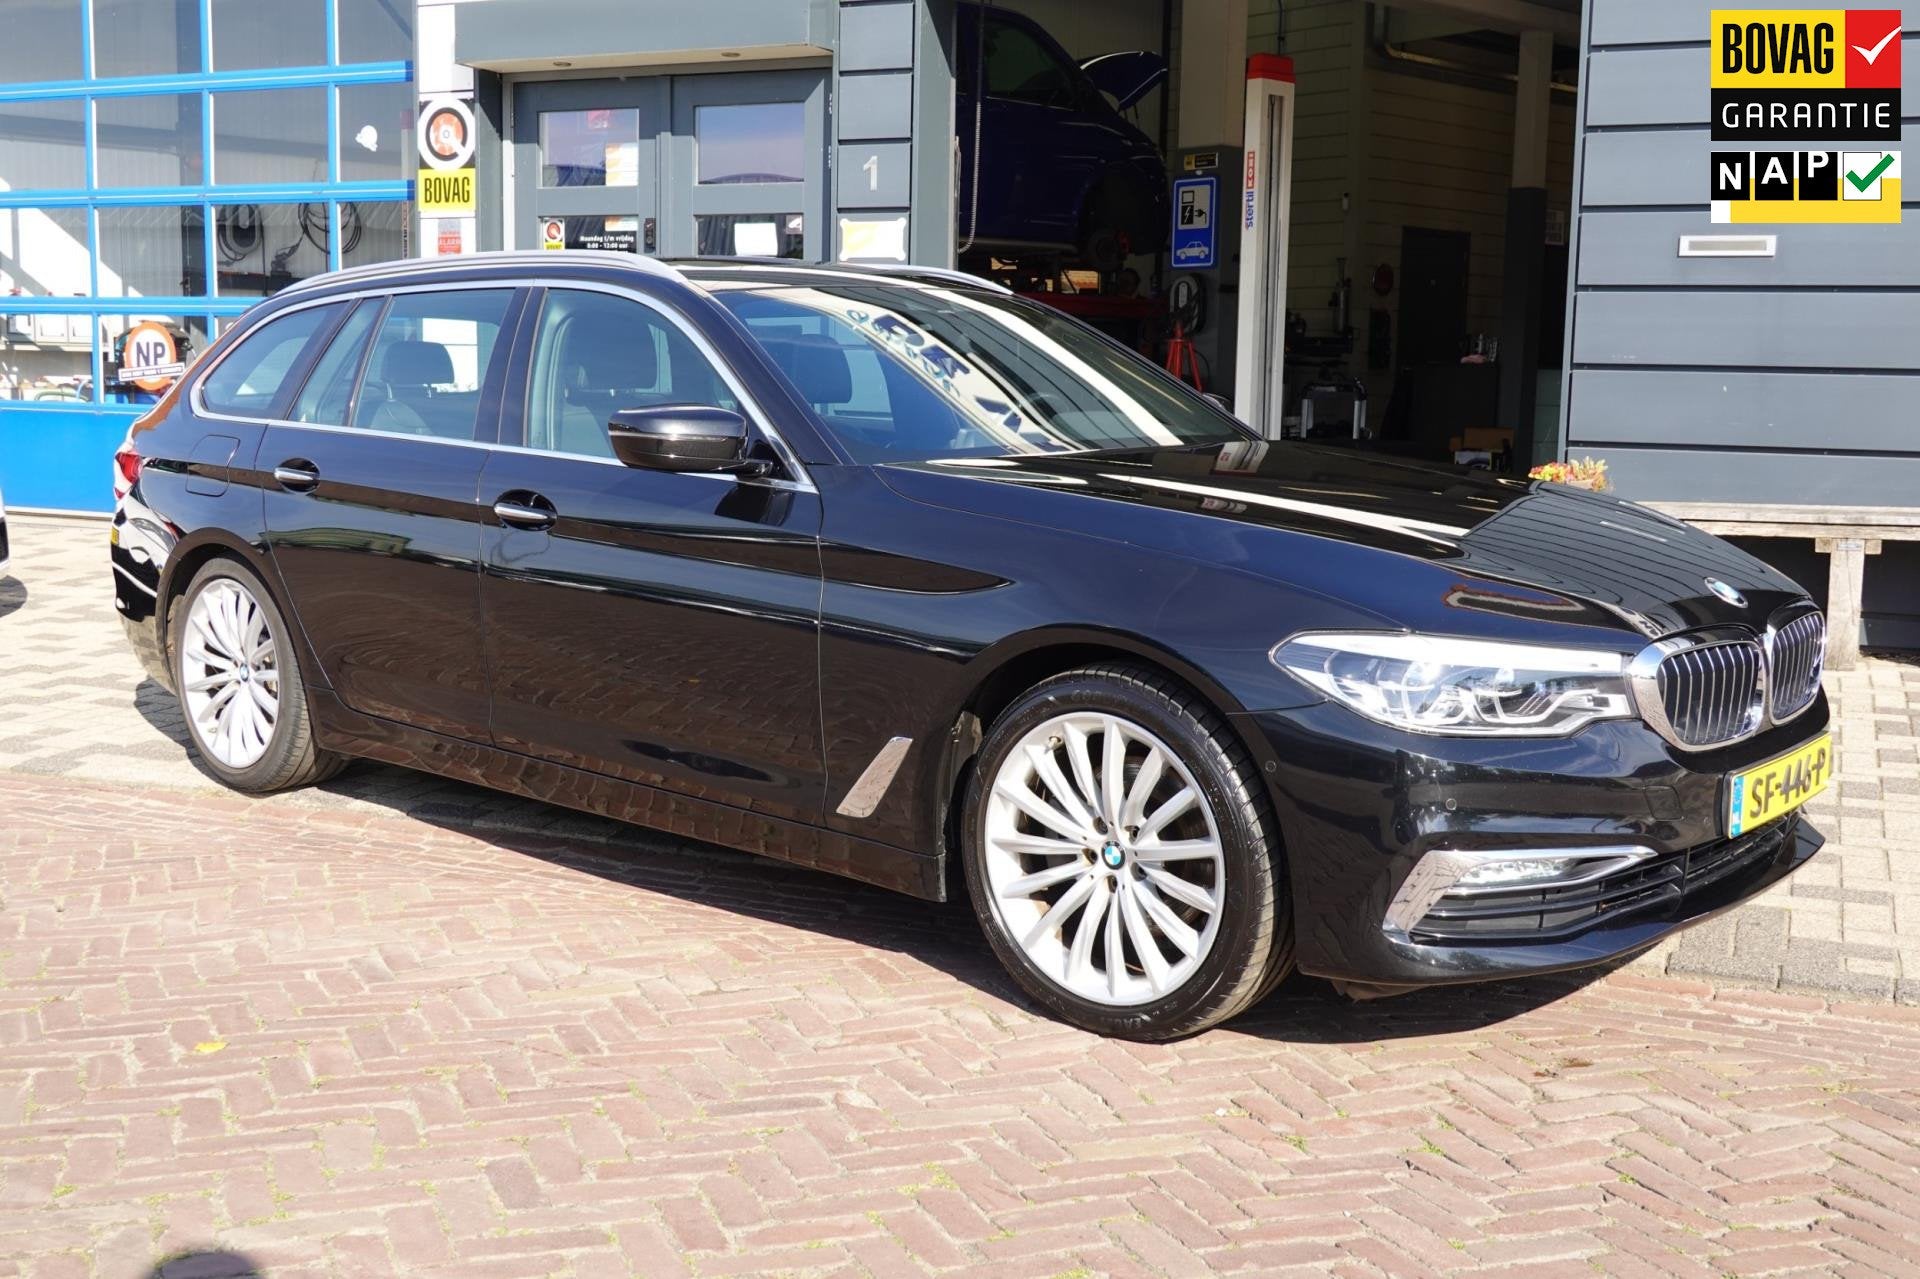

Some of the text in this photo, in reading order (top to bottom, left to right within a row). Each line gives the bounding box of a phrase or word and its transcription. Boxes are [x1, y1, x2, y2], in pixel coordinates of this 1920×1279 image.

[424, 176, 470, 204] BOVAG
[863, 155, 878, 191] 1
[1245, 191, 1254, 228] stertil
[136, 341, 166, 368] NP
[1749, 747, 1826, 819] SF-446-P
